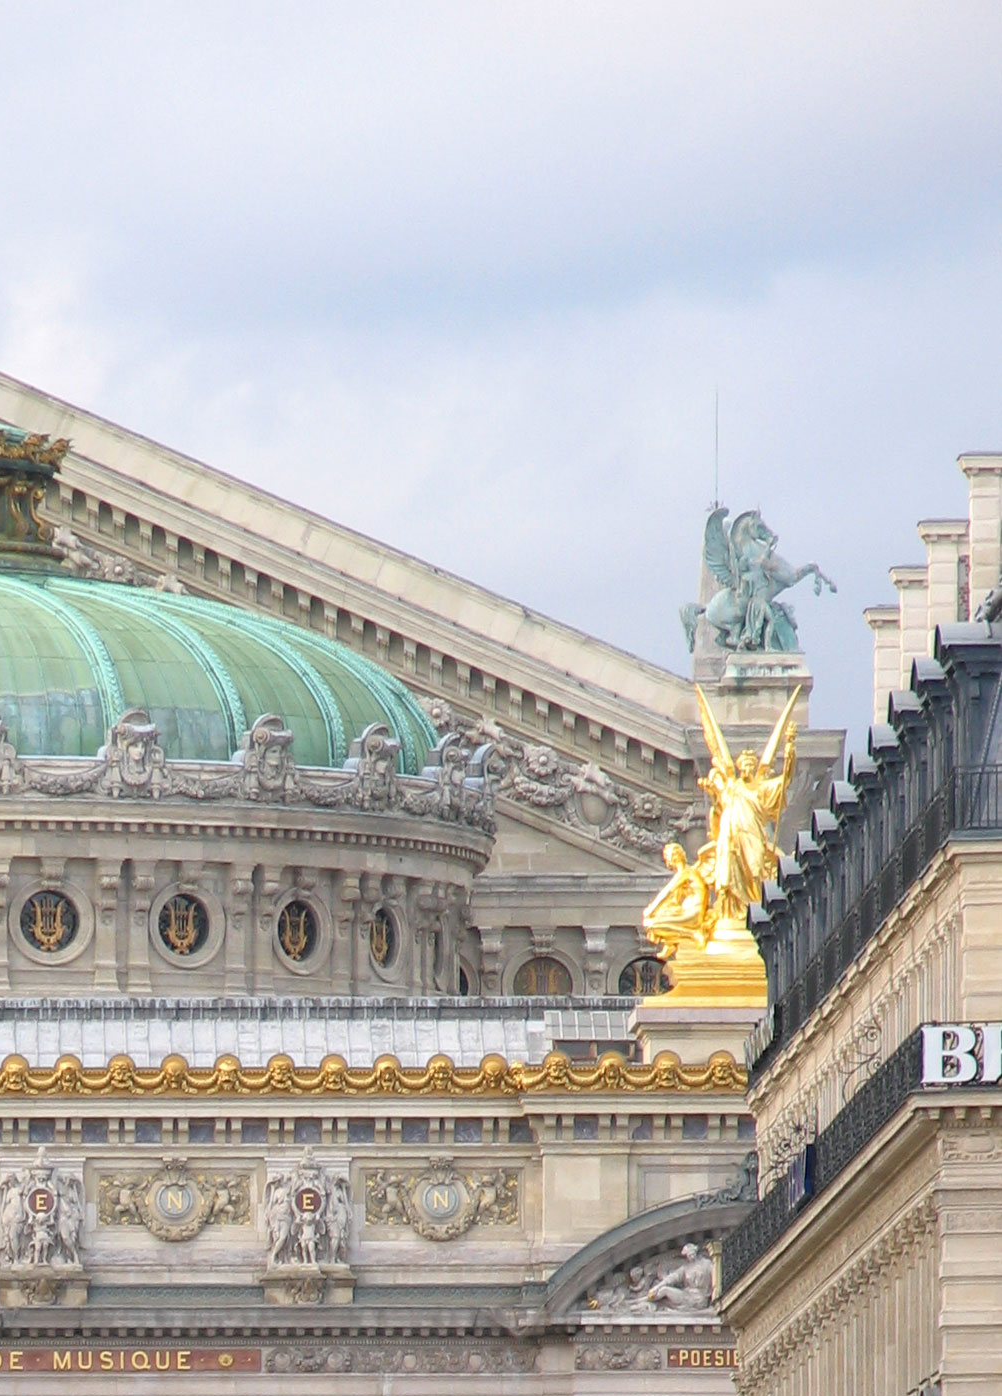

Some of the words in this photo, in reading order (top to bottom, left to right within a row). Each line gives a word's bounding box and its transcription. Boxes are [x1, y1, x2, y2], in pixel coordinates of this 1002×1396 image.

[920, 1026, 1002, 1083] B
[36, 1194, 48, 1210] E
[167, 1191, 183, 1210] N
[302, 1194, 314, 1210] E
[433, 1190, 448, 1209] N
[53, 1351, 191, 1370] MUSIQUE
